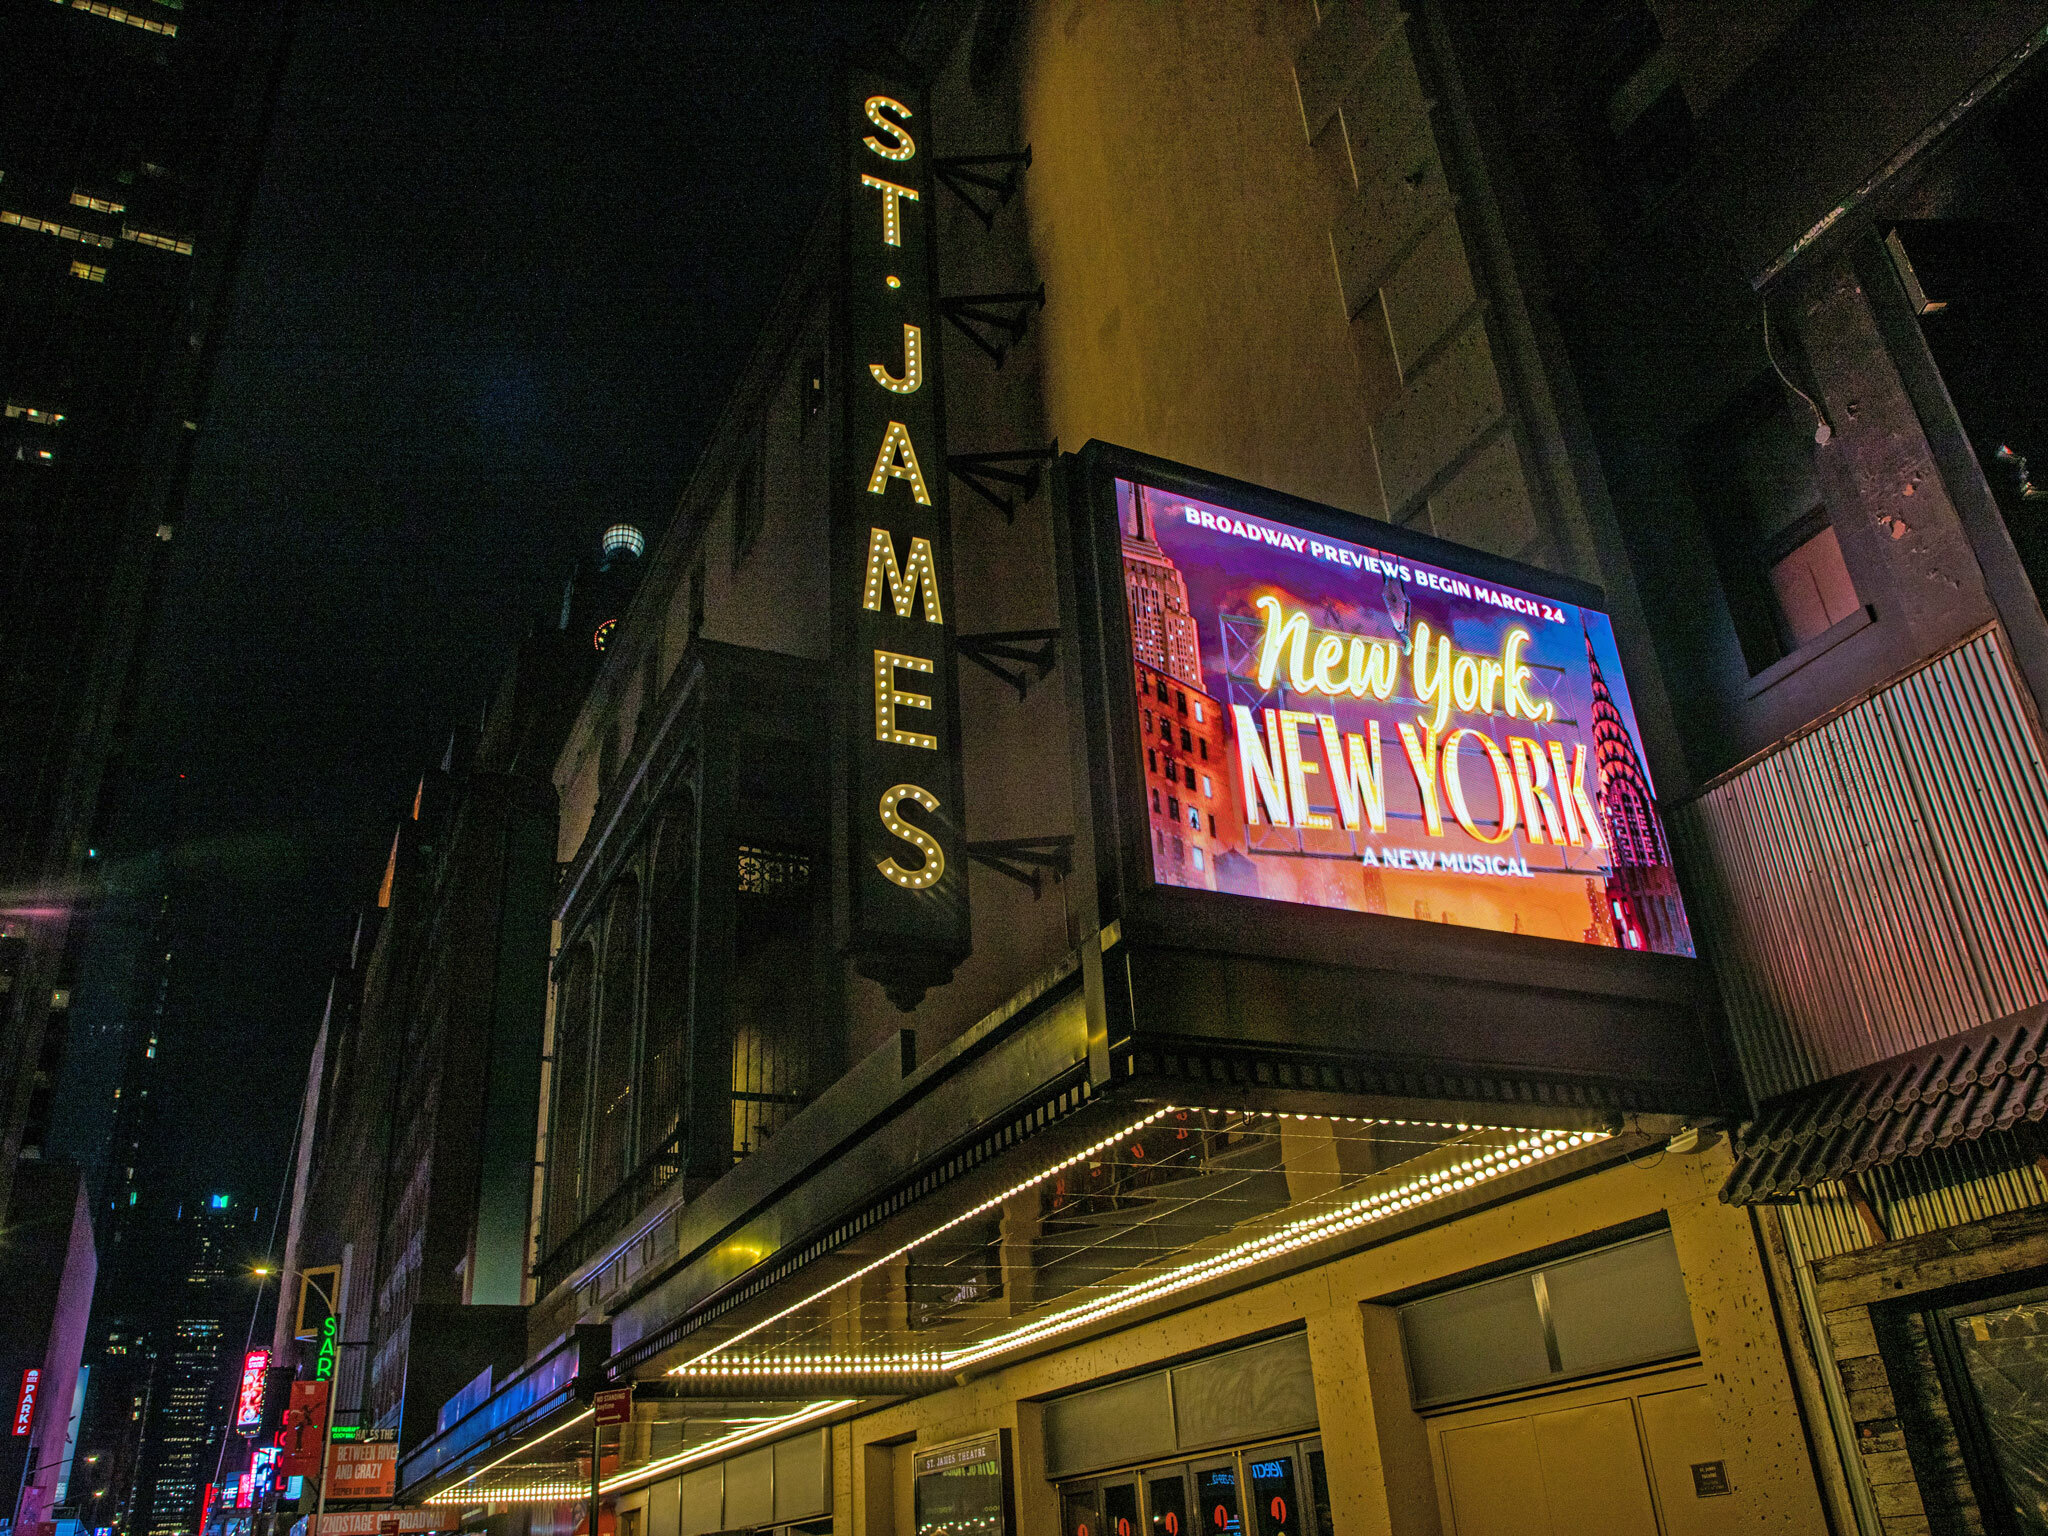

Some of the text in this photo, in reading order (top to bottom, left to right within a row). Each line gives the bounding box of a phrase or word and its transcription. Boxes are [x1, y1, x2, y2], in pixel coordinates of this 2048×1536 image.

[1184, 505, 1566, 624] BROADWAY PREVIEWS BEGIN MARCH 24
[862, 323, 946, 890] JAMES
[1256, 595, 1553, 734] New York,
[1228, 704, 1610, 851] NEW YORK
[1362, 846, 1535, 878] A NEW MUSICAL
[315, 1317, 336, 1382] SAR
[19, 1384, 35, 1424] PARK
[355, 1428, 379, 1441] HAES
[335, 1462, 383, 1480] AND CRAZY
[337, 1445, 376, 1461] BETWEEN
[936, 1454, 956, 1467] JAMES
[958, 1447, 986, 1462] THEATRE
[322, 1513, 373, 1533] 2NDSTAGE
